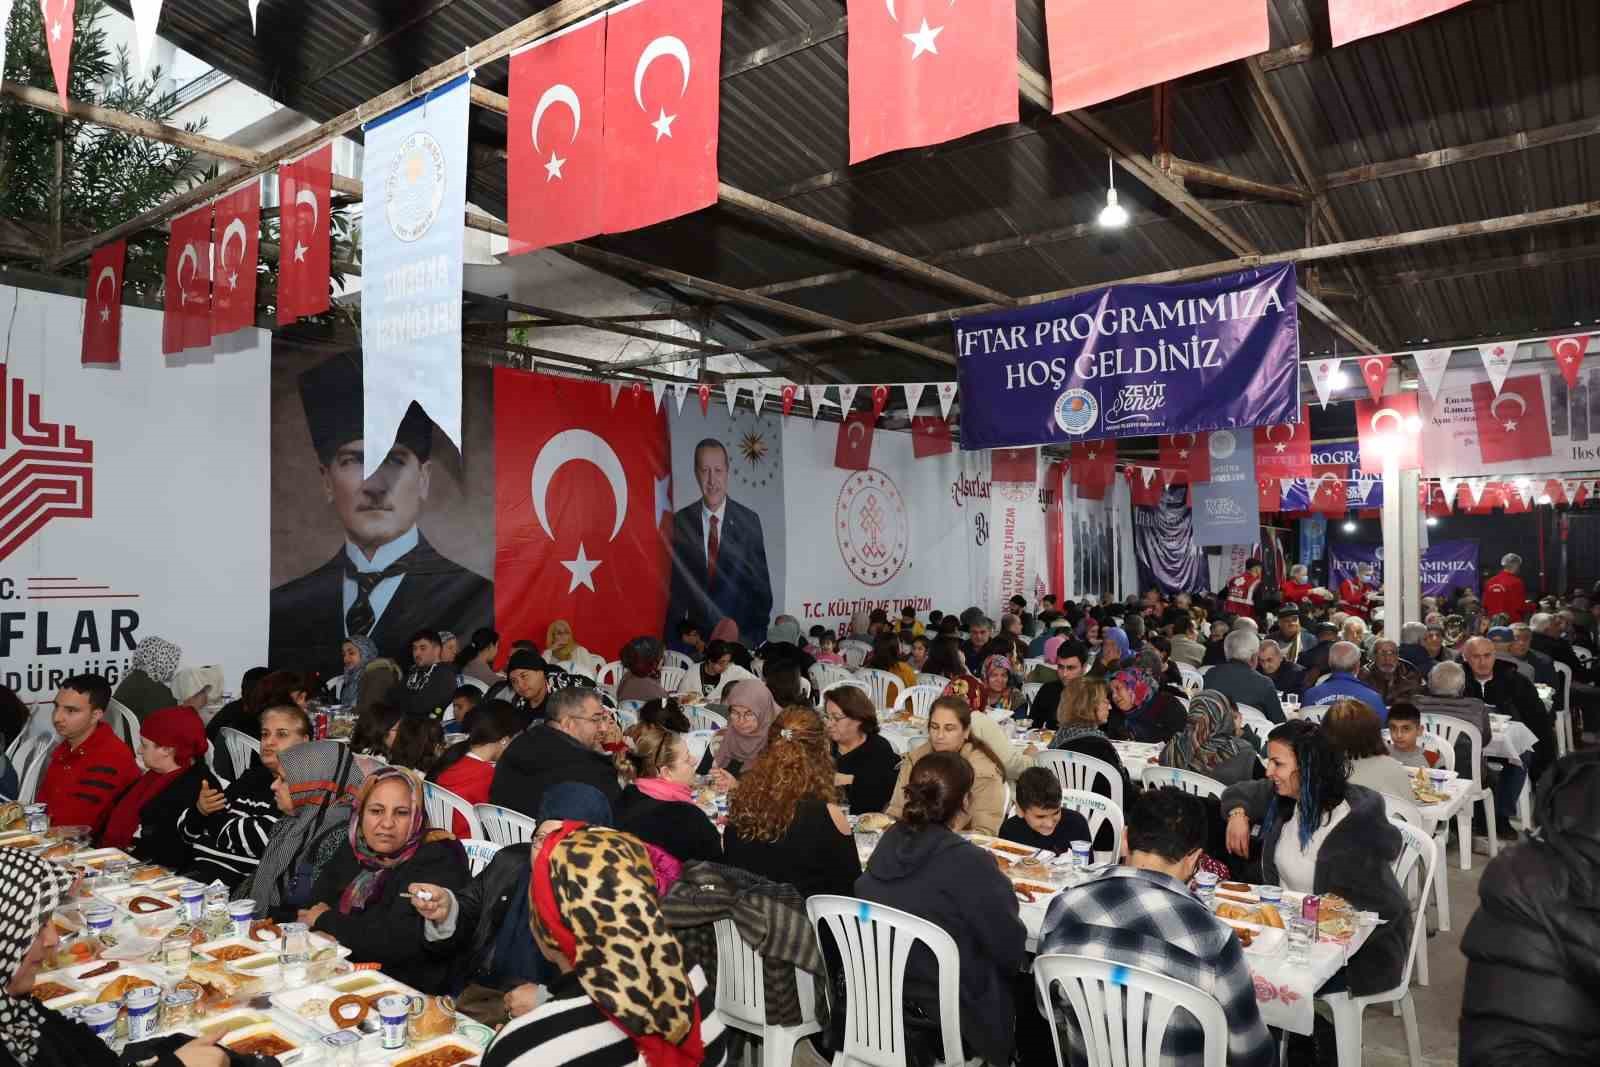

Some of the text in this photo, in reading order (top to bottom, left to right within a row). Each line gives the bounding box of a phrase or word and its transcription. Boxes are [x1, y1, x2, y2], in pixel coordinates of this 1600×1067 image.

[957, 286, 1286, 357] İFTAR PROGRAMIMIZA
[1006, 335, 1222, 390] HOŞ GELDİNİZ
[1124, 380, 1167, 397] ZEYİT
[1002, 507, 1016, 613] KÜLTÜR VE TURİZM
[1015, 541, 1026, 595] AKANLIĞI
[803, 602, 825, 618] T.C.
[828, 598, 873, 617] KÜLTÜR
